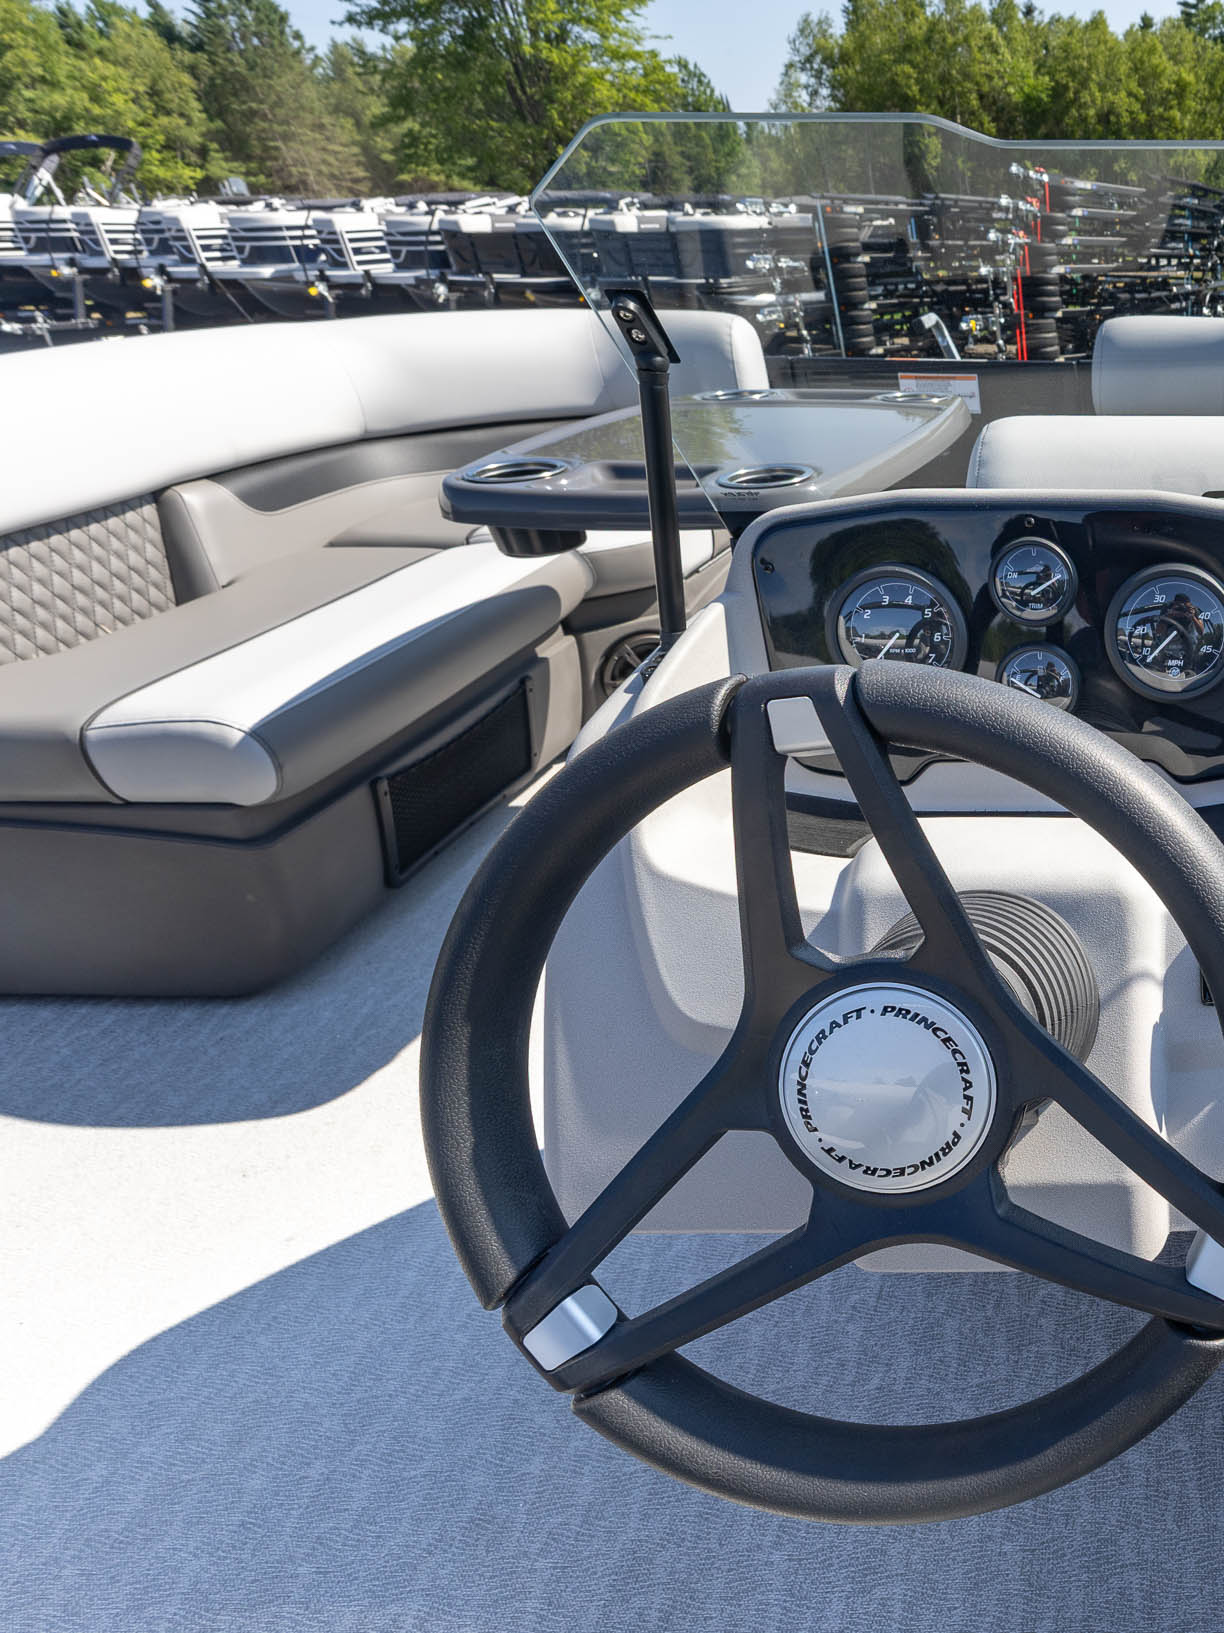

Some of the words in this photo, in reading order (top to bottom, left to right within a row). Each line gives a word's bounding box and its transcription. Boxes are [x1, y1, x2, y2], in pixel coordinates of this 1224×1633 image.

[881, 595, 890, 605] 3
[904, 595, 913, 605] 4
[1153, 594, 1166, 603] 30
[863, 609, 871, 619] 2
[923, 608, 932, 618] 5
[1198, 612, 1211, 620] 40
[1134, 626, 1147, 634] 20
[860, 633, 866, 643] 1
[933, 632, 942, 642] 6
[1142, 647, 1151, 656] 10
[1200, 645, 1213, 653] 45
[928, 653, 936, 663] 7
[1167, 659, 1184, 667] MPH
[880, 1005, 974, 1121] PRINCECRAFT
[796, 1006, 867, 1133] PRINCECRAFT
[820, 1130, 962, 1178] PRINCECRAFT
